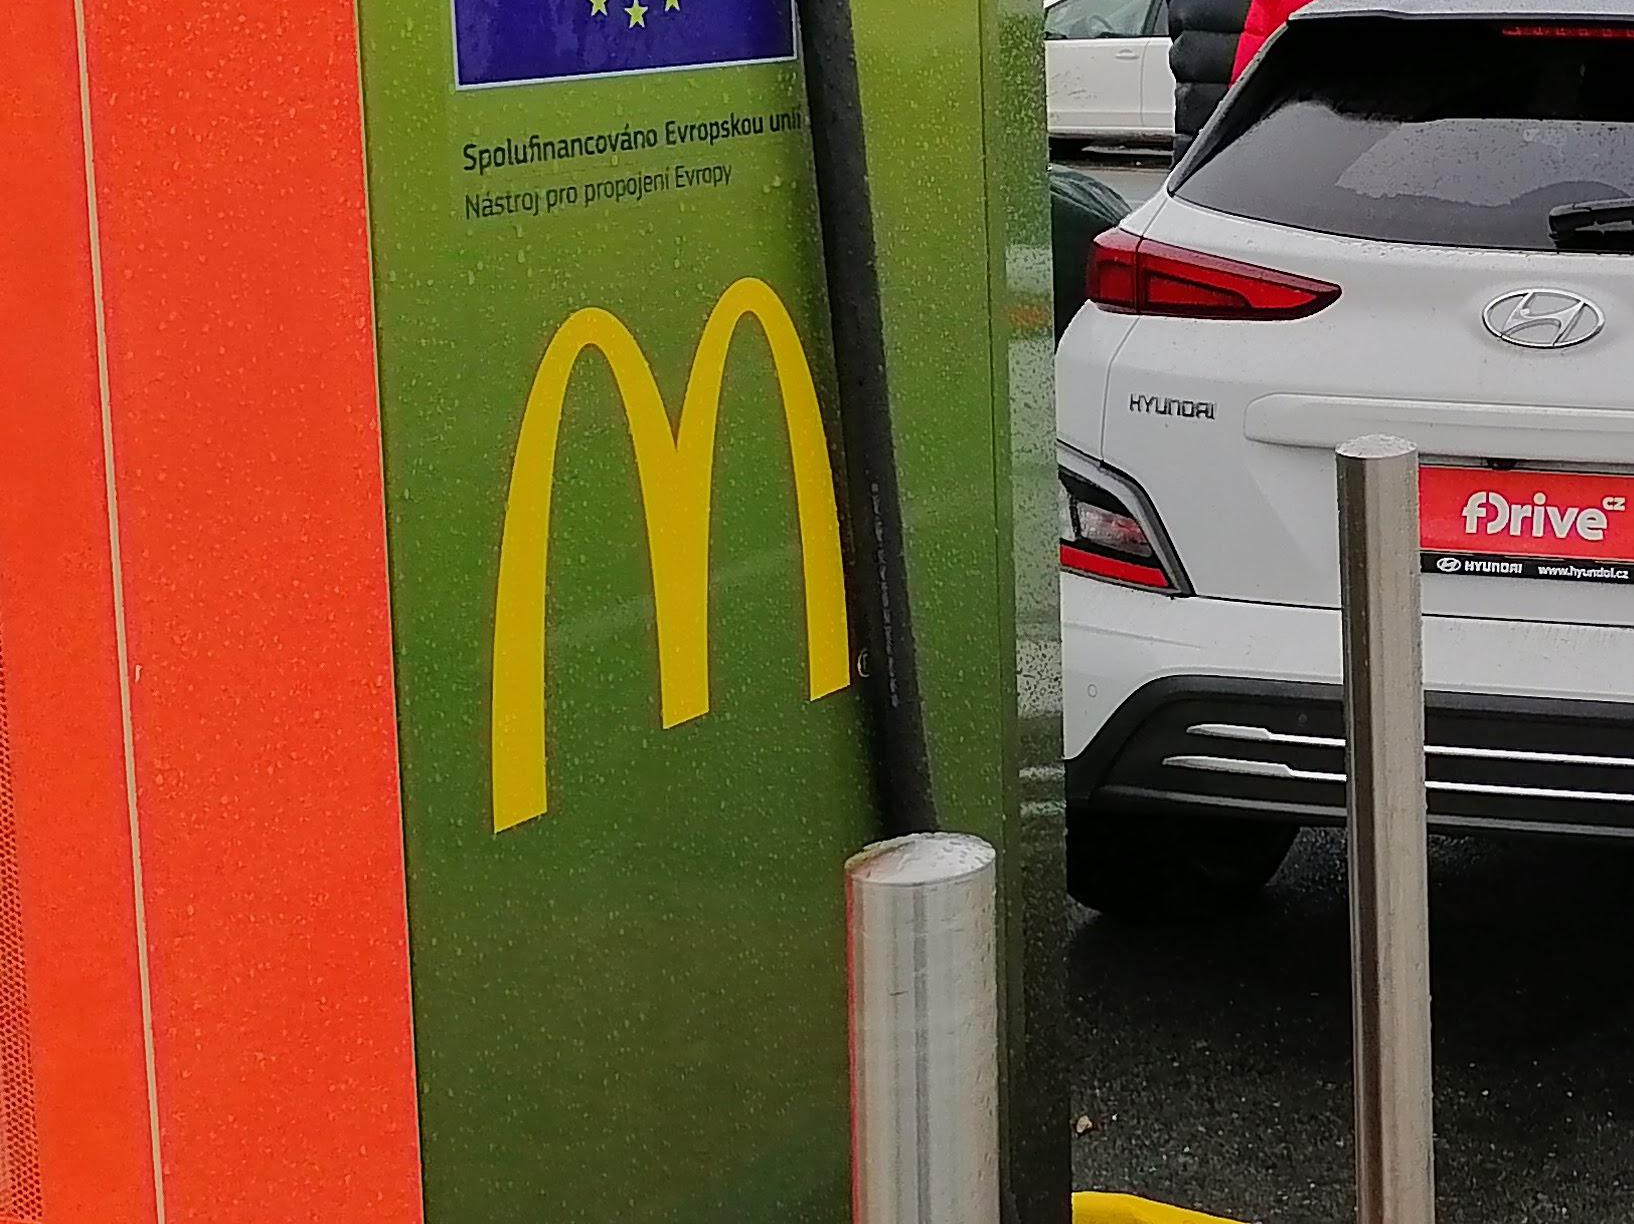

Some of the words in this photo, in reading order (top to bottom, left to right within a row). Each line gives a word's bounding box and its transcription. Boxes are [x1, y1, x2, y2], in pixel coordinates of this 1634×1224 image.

[463, 123, 658, 175] Spolufinancováno
[665, 112, 764, 144] Evropskou
[466, 191, 540, 220] Nástroj
[547, 187, 578, 213] pro
[675, 163, 732, 187] Evropy
[1128, 392, 1216, 420] HYUNDAI
[1464, 560, 1522, 574] HYUNDAI
